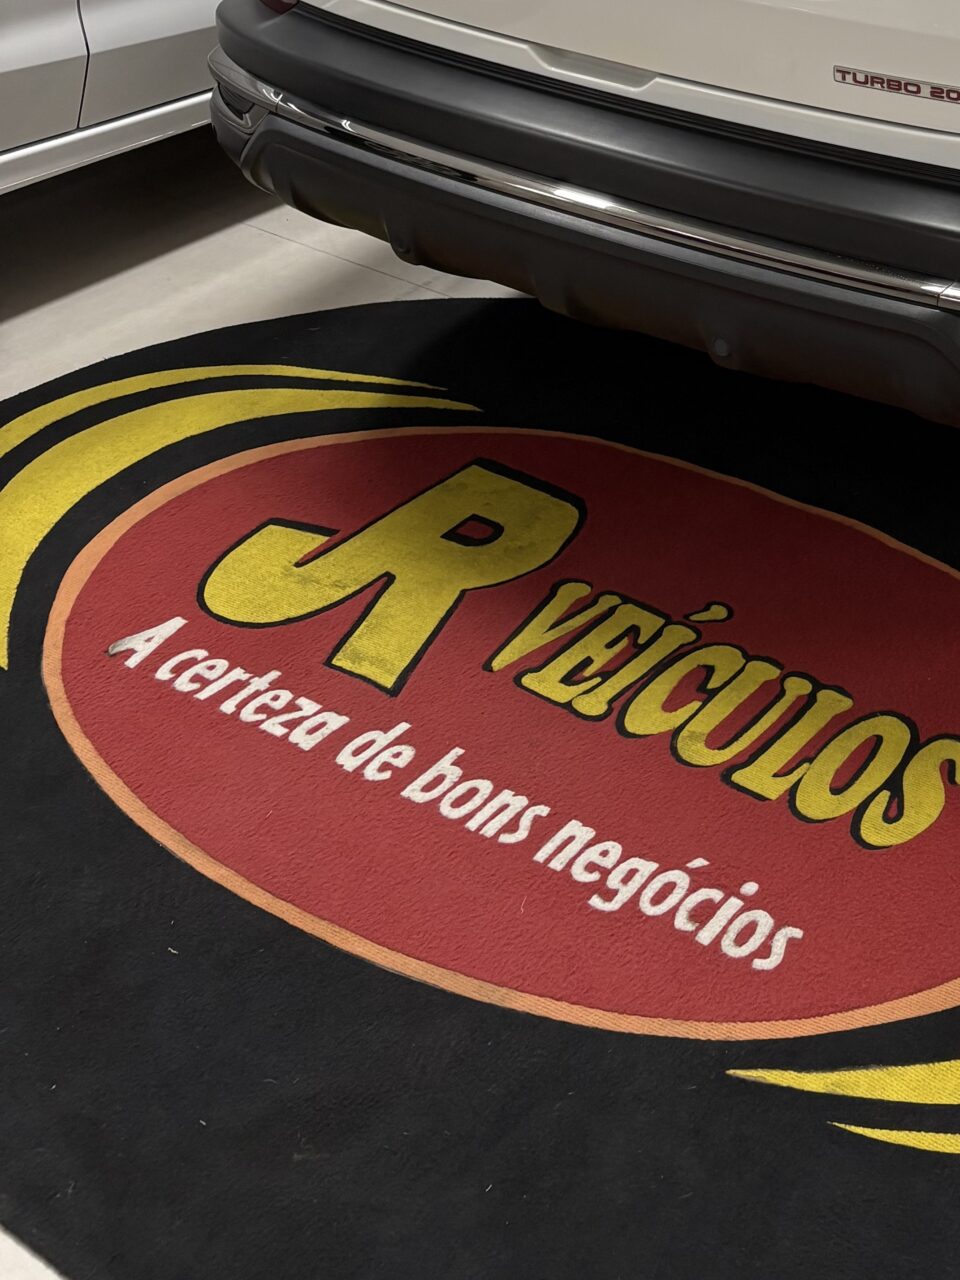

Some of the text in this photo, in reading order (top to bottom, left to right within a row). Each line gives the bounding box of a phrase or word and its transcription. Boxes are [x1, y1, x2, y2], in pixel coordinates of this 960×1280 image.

[835, 68, 921, 95] TURBO
[108, 616, 804, 971] A certeza de bons negócios
